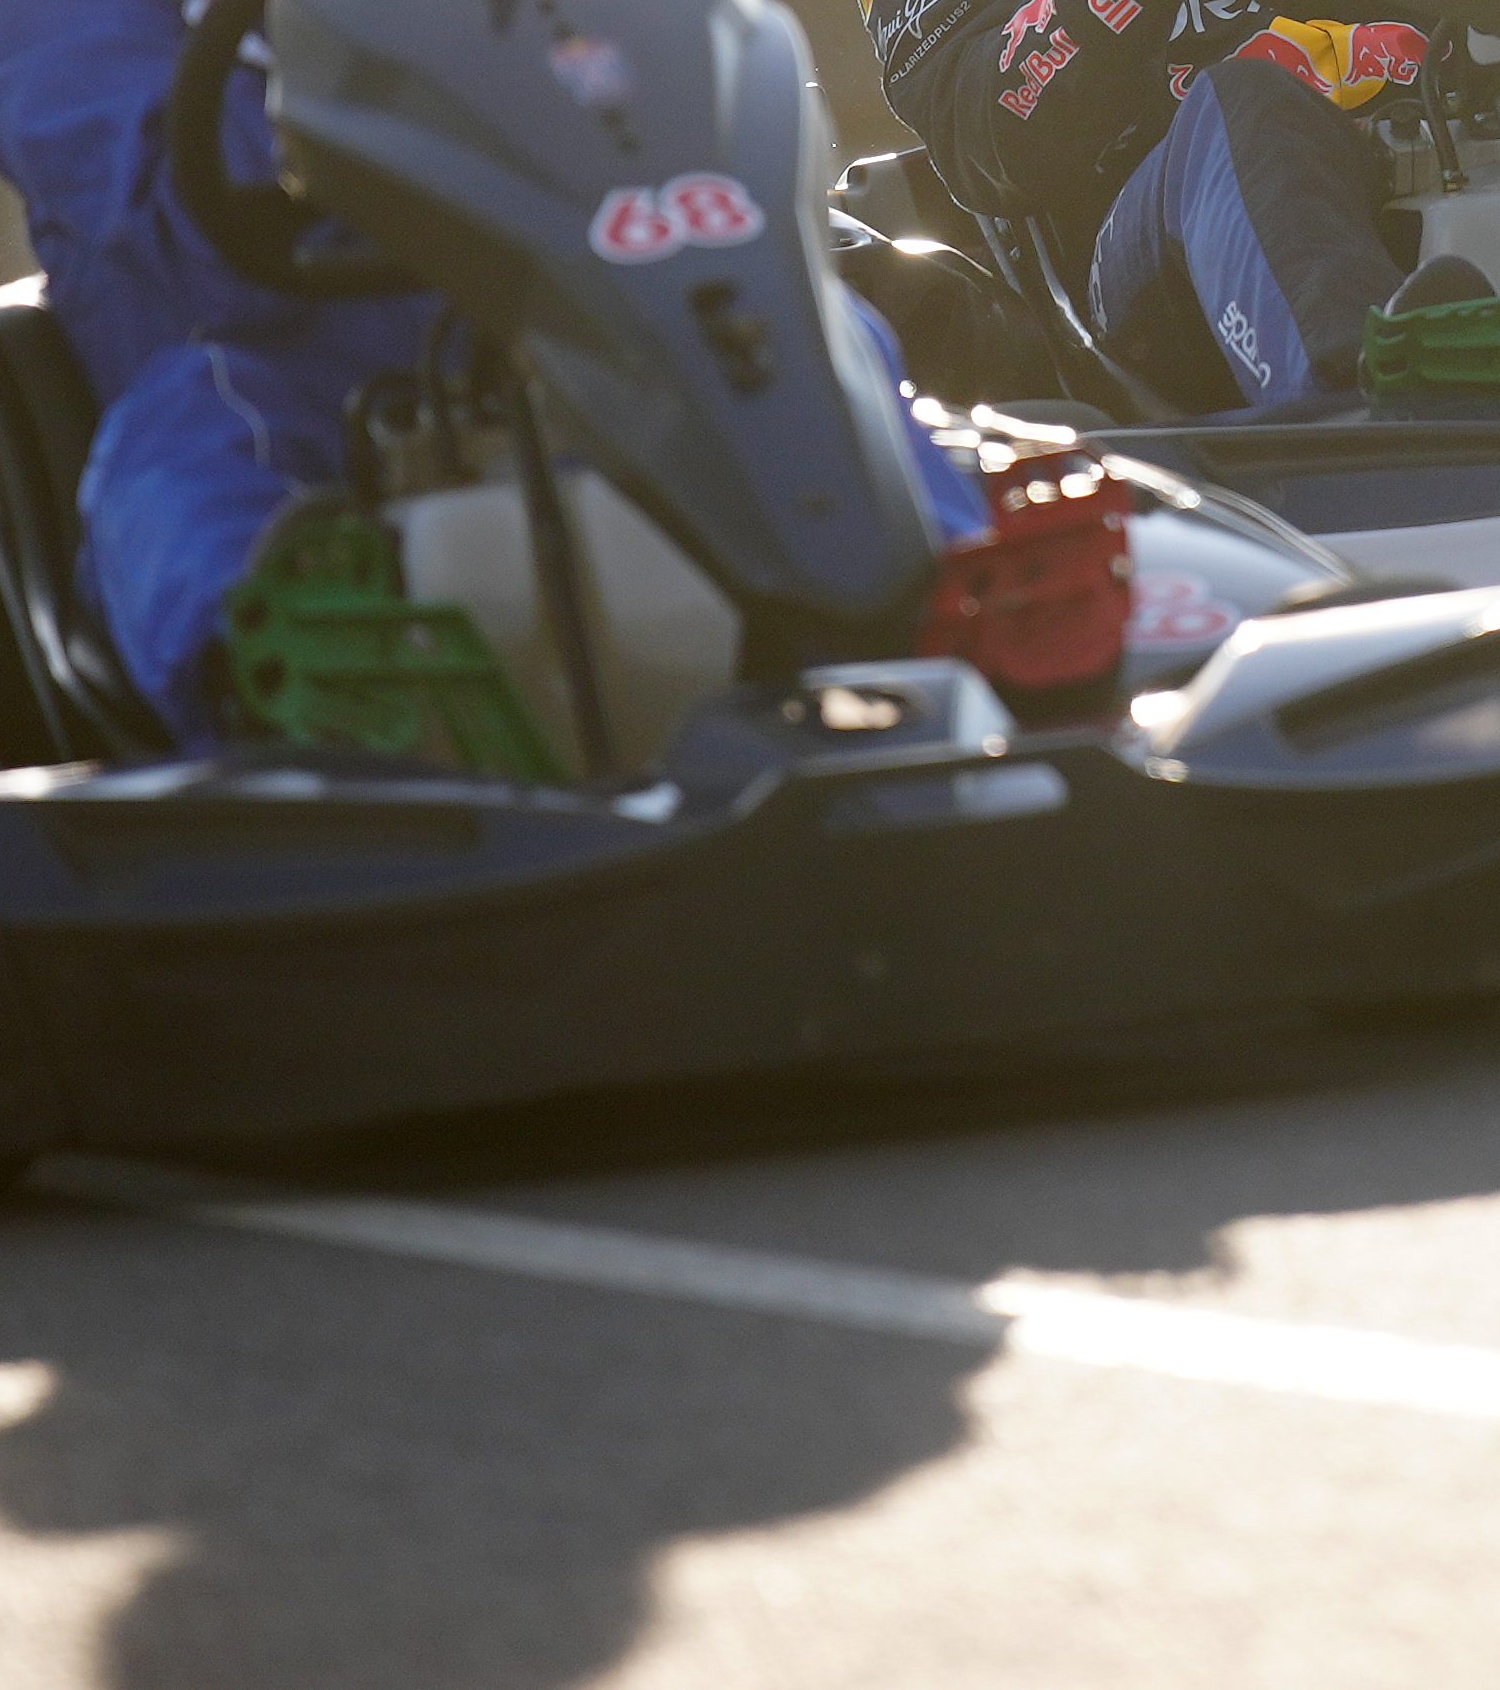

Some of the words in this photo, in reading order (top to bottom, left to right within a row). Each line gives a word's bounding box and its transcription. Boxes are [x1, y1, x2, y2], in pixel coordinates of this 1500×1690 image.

[889, 0, 972, 84] OLARIZEDPLUS2
[998, 61, 1043, 120] Red
[1025, 26, 1080, 88] Bull
[588, 172, 766, 264] 68
